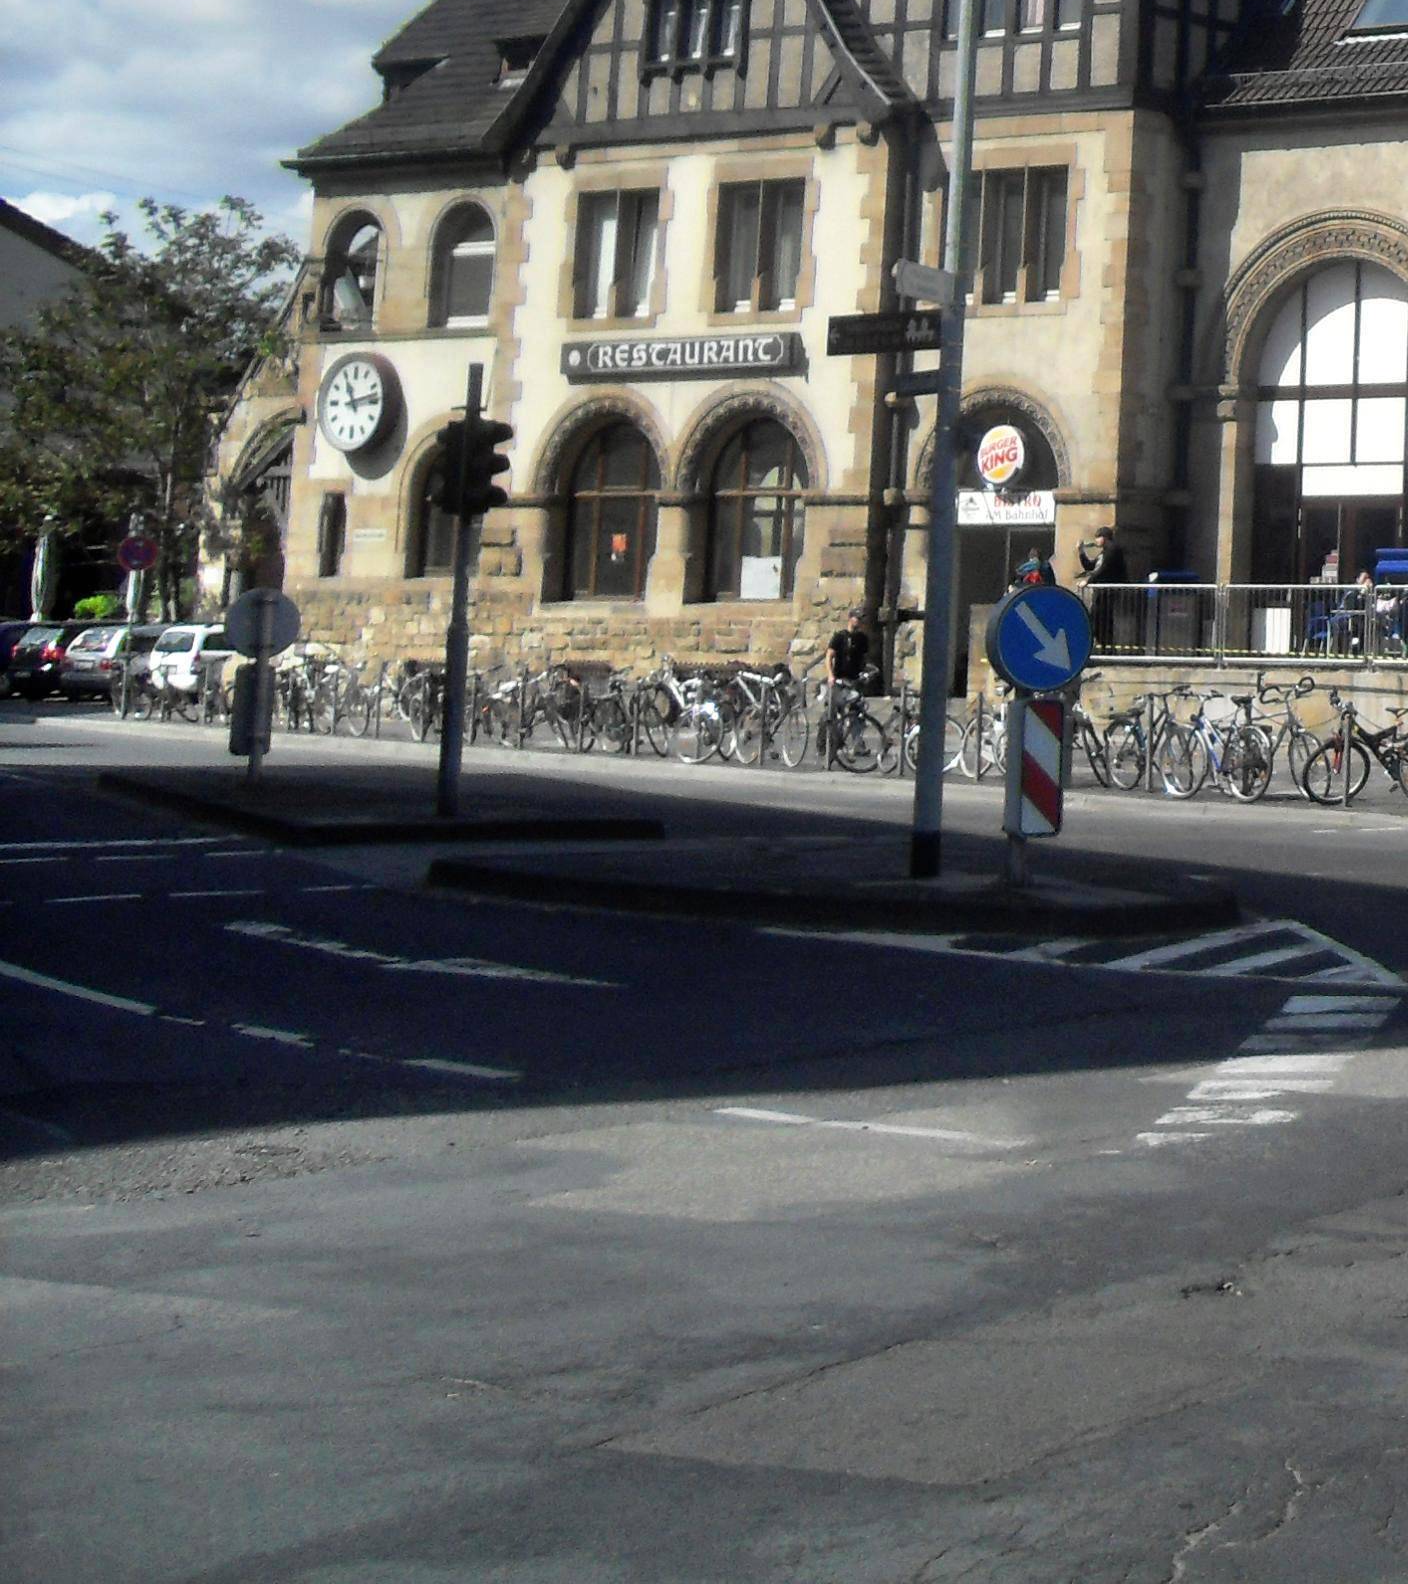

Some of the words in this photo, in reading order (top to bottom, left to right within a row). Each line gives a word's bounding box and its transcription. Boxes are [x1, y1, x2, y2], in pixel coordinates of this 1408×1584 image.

[597, 338, 774, 368] RESTAURANT
[980, 435, 1018, 458] BURGER
[981, 447, 1018, 474] KING
